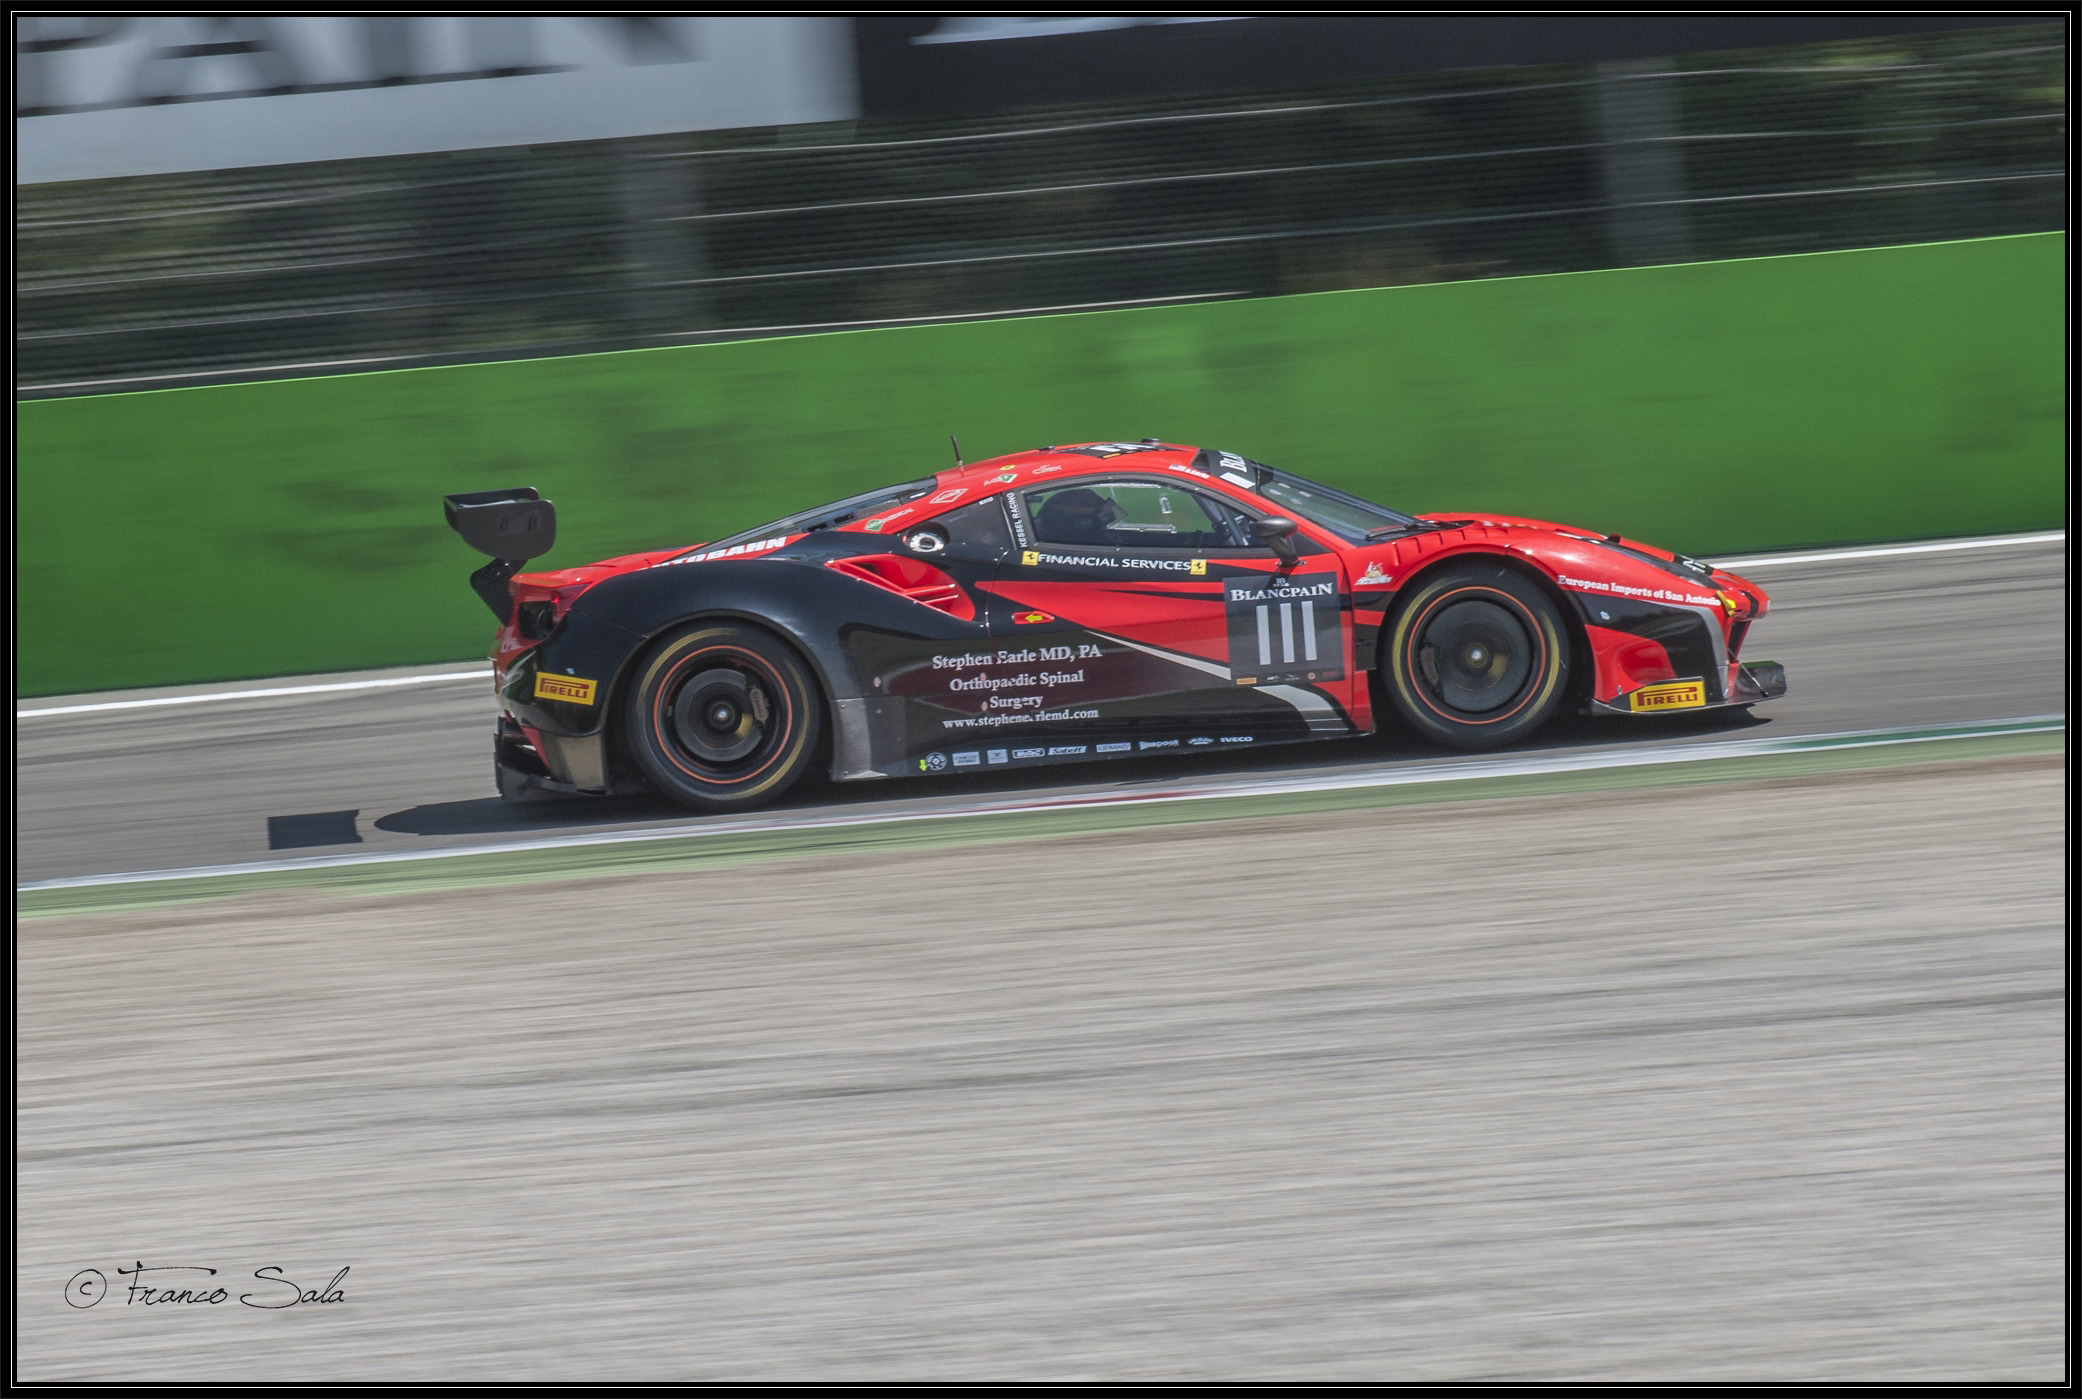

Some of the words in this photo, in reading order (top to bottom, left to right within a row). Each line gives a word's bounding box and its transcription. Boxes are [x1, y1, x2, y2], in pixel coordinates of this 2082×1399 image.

[1006, 491, 1022, 519] RACING
[1014, 519, 1028, 548] KESSEL
[1038, 553, 1119, 567] FINANCIAL
[1122, 558, 1191, 571] SERVICES
[1230, 582, 1333, 602] BLANCPAIN
[1557, 575, 1609, 590] European
[1611, 582, 1652, 597] Imports
[1653, 589, 1664, 599] of
[1665, 590, 1683, 602] San
[1256, 600, 1317, 665] 111
[932, 652, 993, 671] Stephen
[997, 649, 1036, 665] Earle
[1039, 646, 1075, 662] MD,
[1078, 644, 1103, 658] PA
[540, 678, 589, 698] PIRELLI
[1040, 669, 1085, 687] Spinal
[990, 696, 1043, 709] Surgery
[1637, 687, 1697, 706] PIRELLI
[942, 709, 1099, 728] www.stephenerlemd.com
